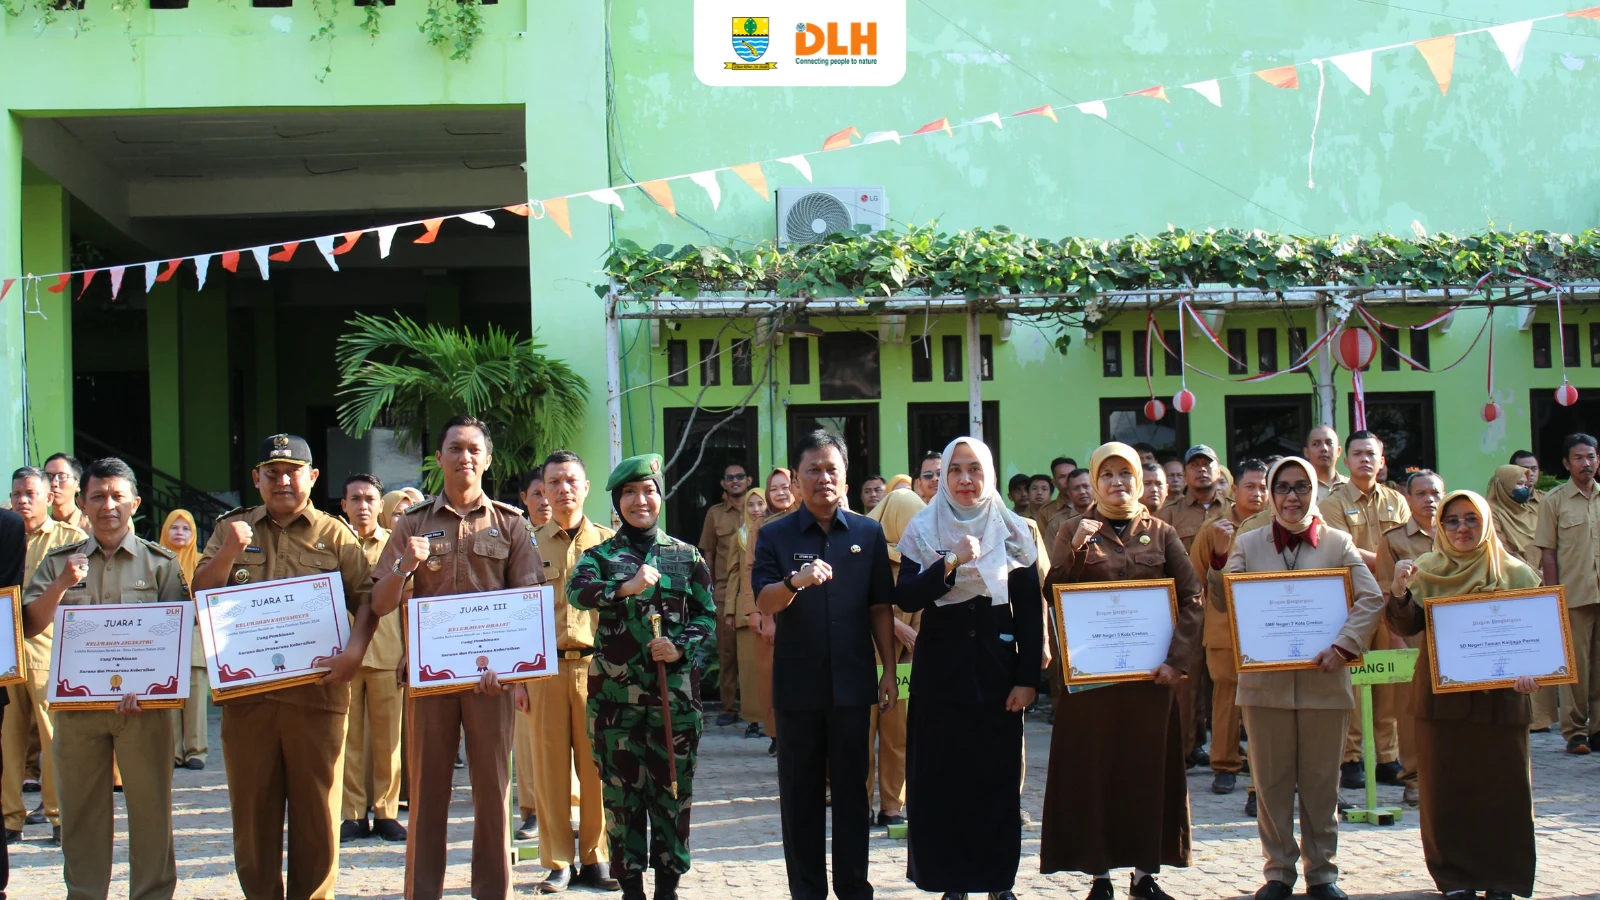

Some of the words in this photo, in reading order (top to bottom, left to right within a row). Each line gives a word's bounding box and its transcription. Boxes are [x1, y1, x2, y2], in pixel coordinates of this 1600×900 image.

[250, 597, 281, 608] JUARA
[460, 604, 489, 614] JUARA
[104, 619, 134, 628] JUARA
[236, 619, 270, 628] KELURAHAN
[1388, 662, 1394, 672] II
